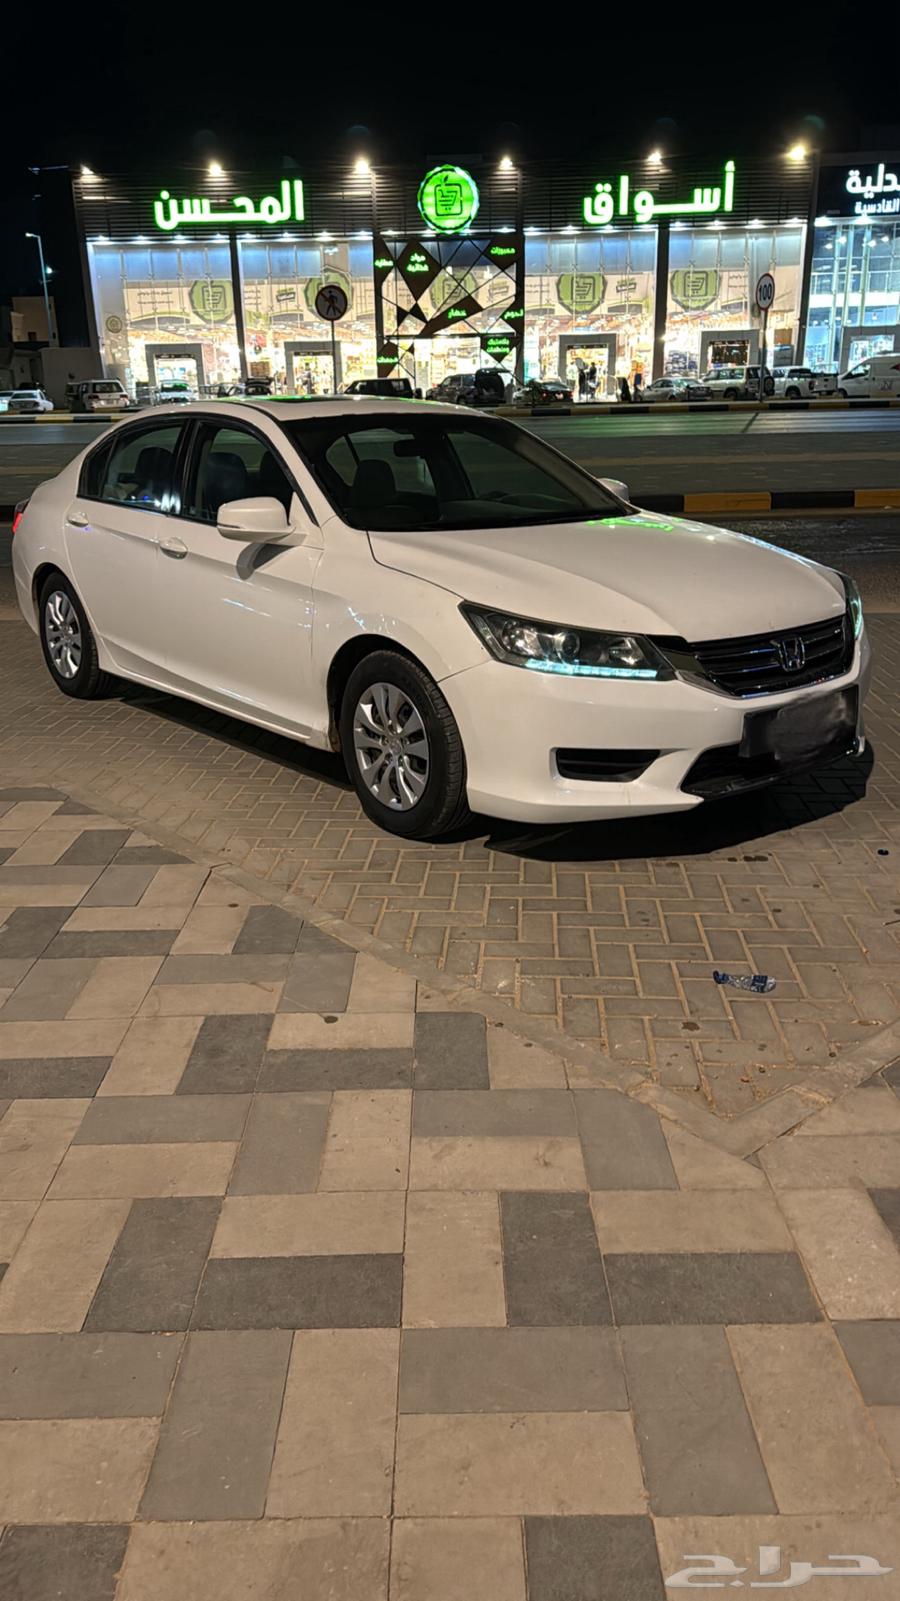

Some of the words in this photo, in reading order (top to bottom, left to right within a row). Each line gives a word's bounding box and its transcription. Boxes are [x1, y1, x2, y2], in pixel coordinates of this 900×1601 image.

[584, 160, 735, 224] أسواق
[846, 163, 900, 199] دلية
[154, 180, 304, 230] المحسن
[854, 198, 900, 215] القادسية
[759, 283, 773, 301] 100
[504, 308, 524, 320] لحوم
